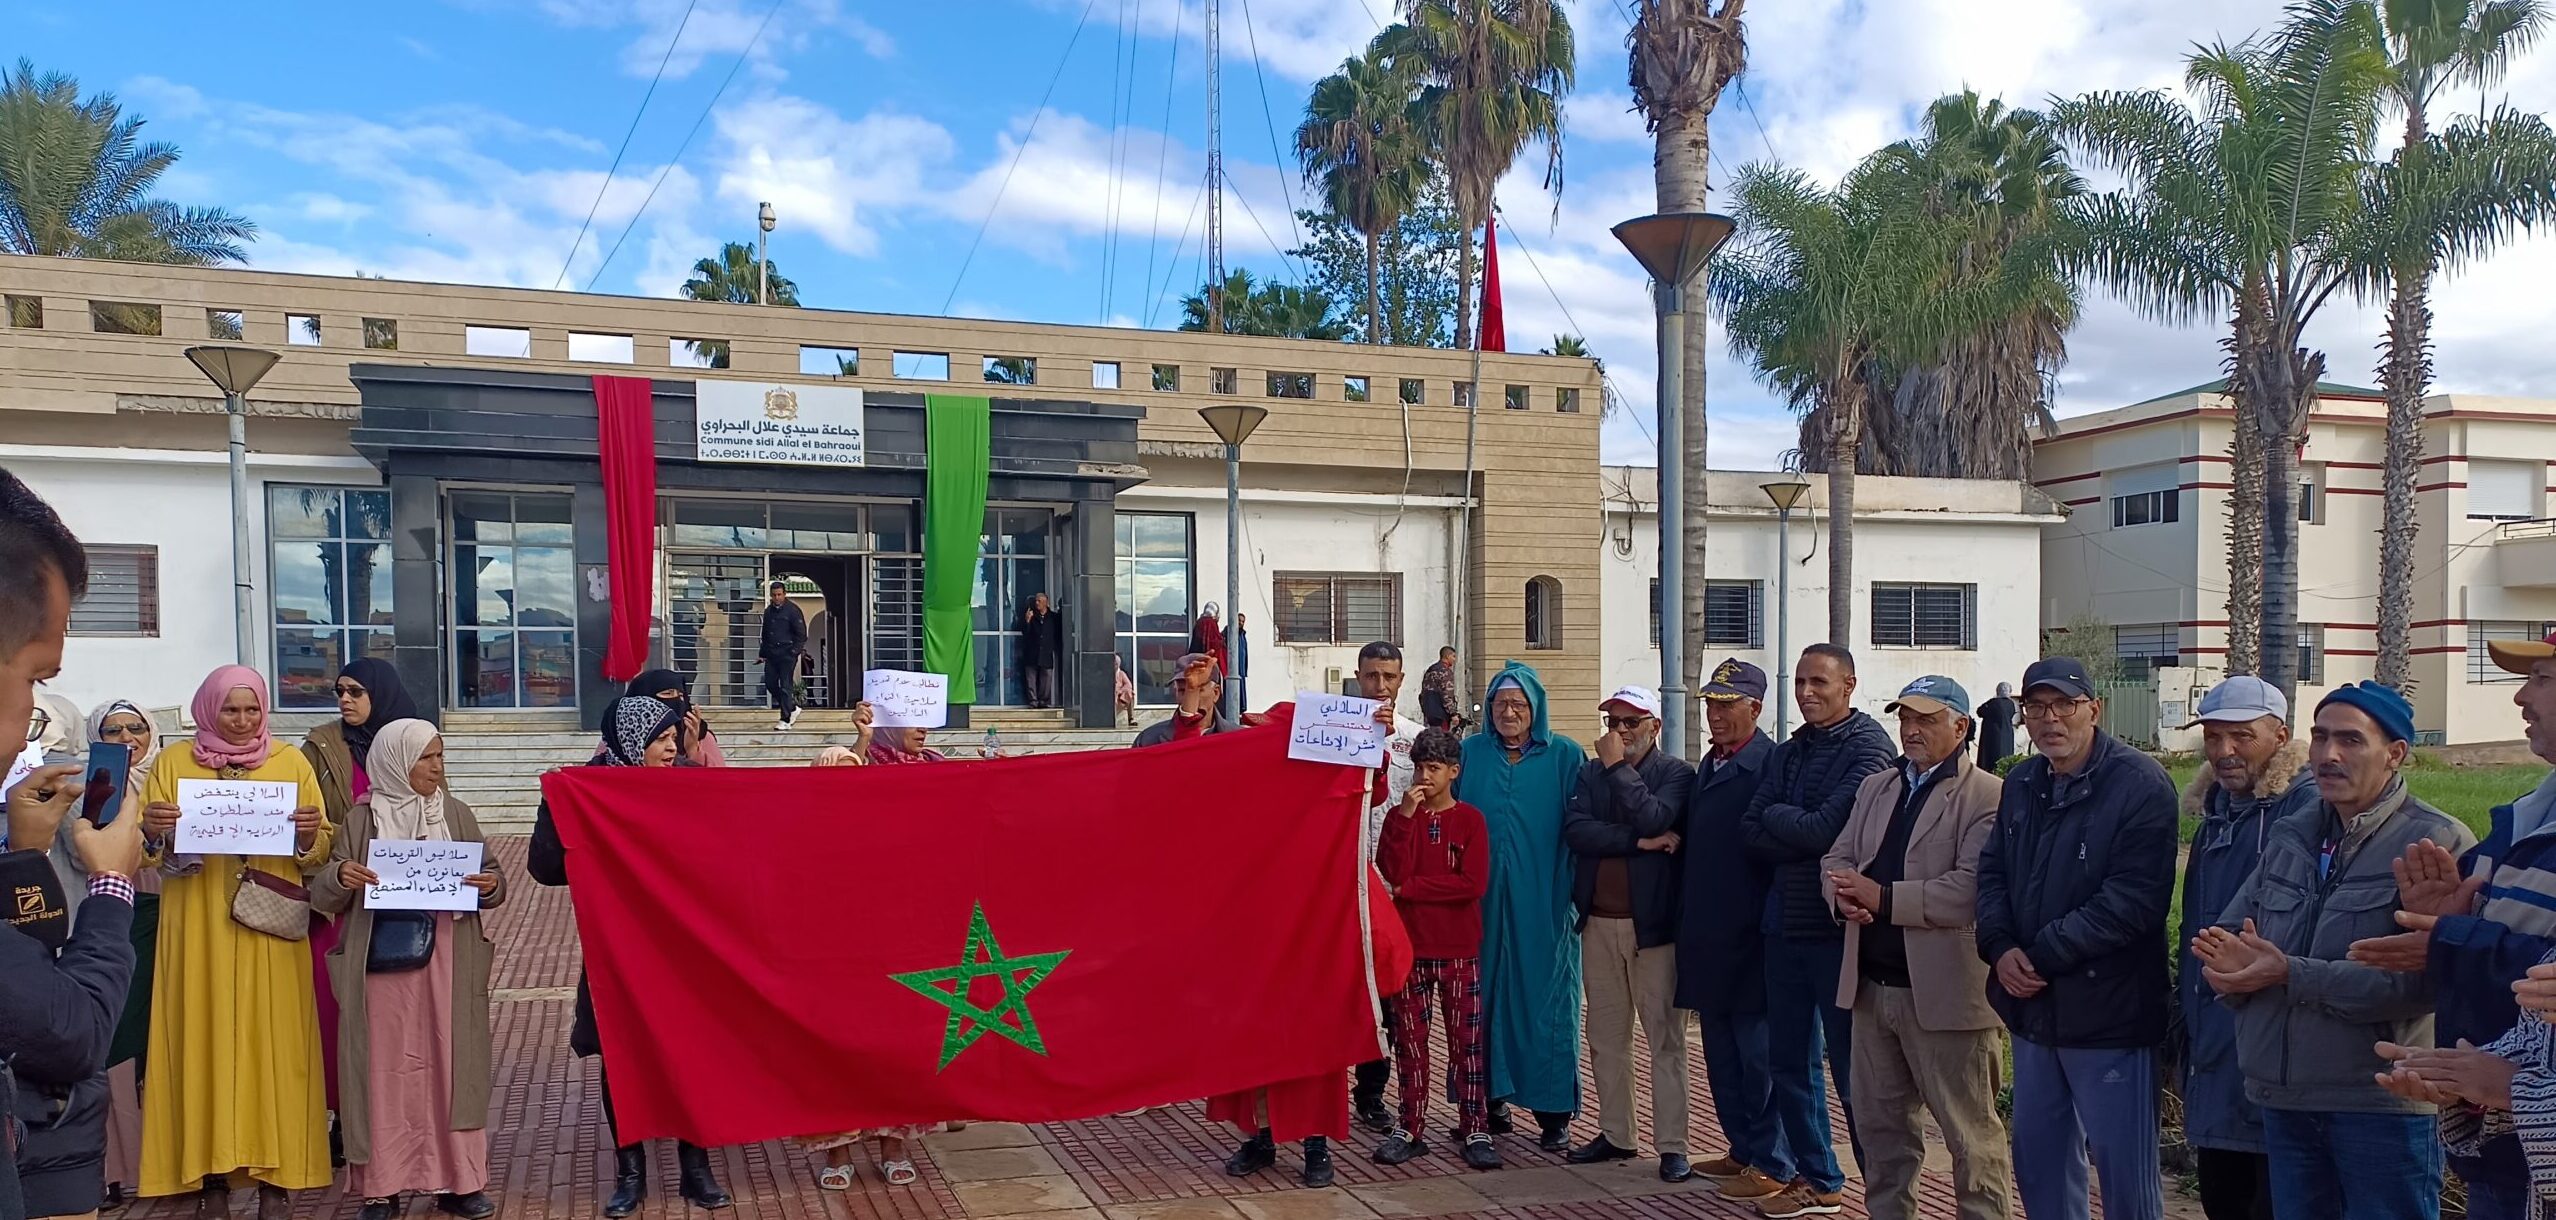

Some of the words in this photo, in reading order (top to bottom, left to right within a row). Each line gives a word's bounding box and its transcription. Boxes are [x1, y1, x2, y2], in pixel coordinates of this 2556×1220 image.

[701, 419, 750, 435] البحراوي
[752, 420, 779, 435] علال
[782, 424, 819, 438] سيدي
[822, 424, 860, 439] جماعة
[700, 436, 753, 445] Commune
[756, 437, 774, 446] sidi
[777, 439, 799, 447] Allal
[801, 440, 811, 448] el
[814, 441, 861, 450] Bahraoui
[1320, 700, 1369, 718] السلالي
[1295, 730, 1348, 752] الإشاعات
[1349, 739, 1376, 757] نشر
[406, 866, 421, 878] من
[15, 886, 42, 894] جريدة
[39, 908, 64, 919] الدولة
